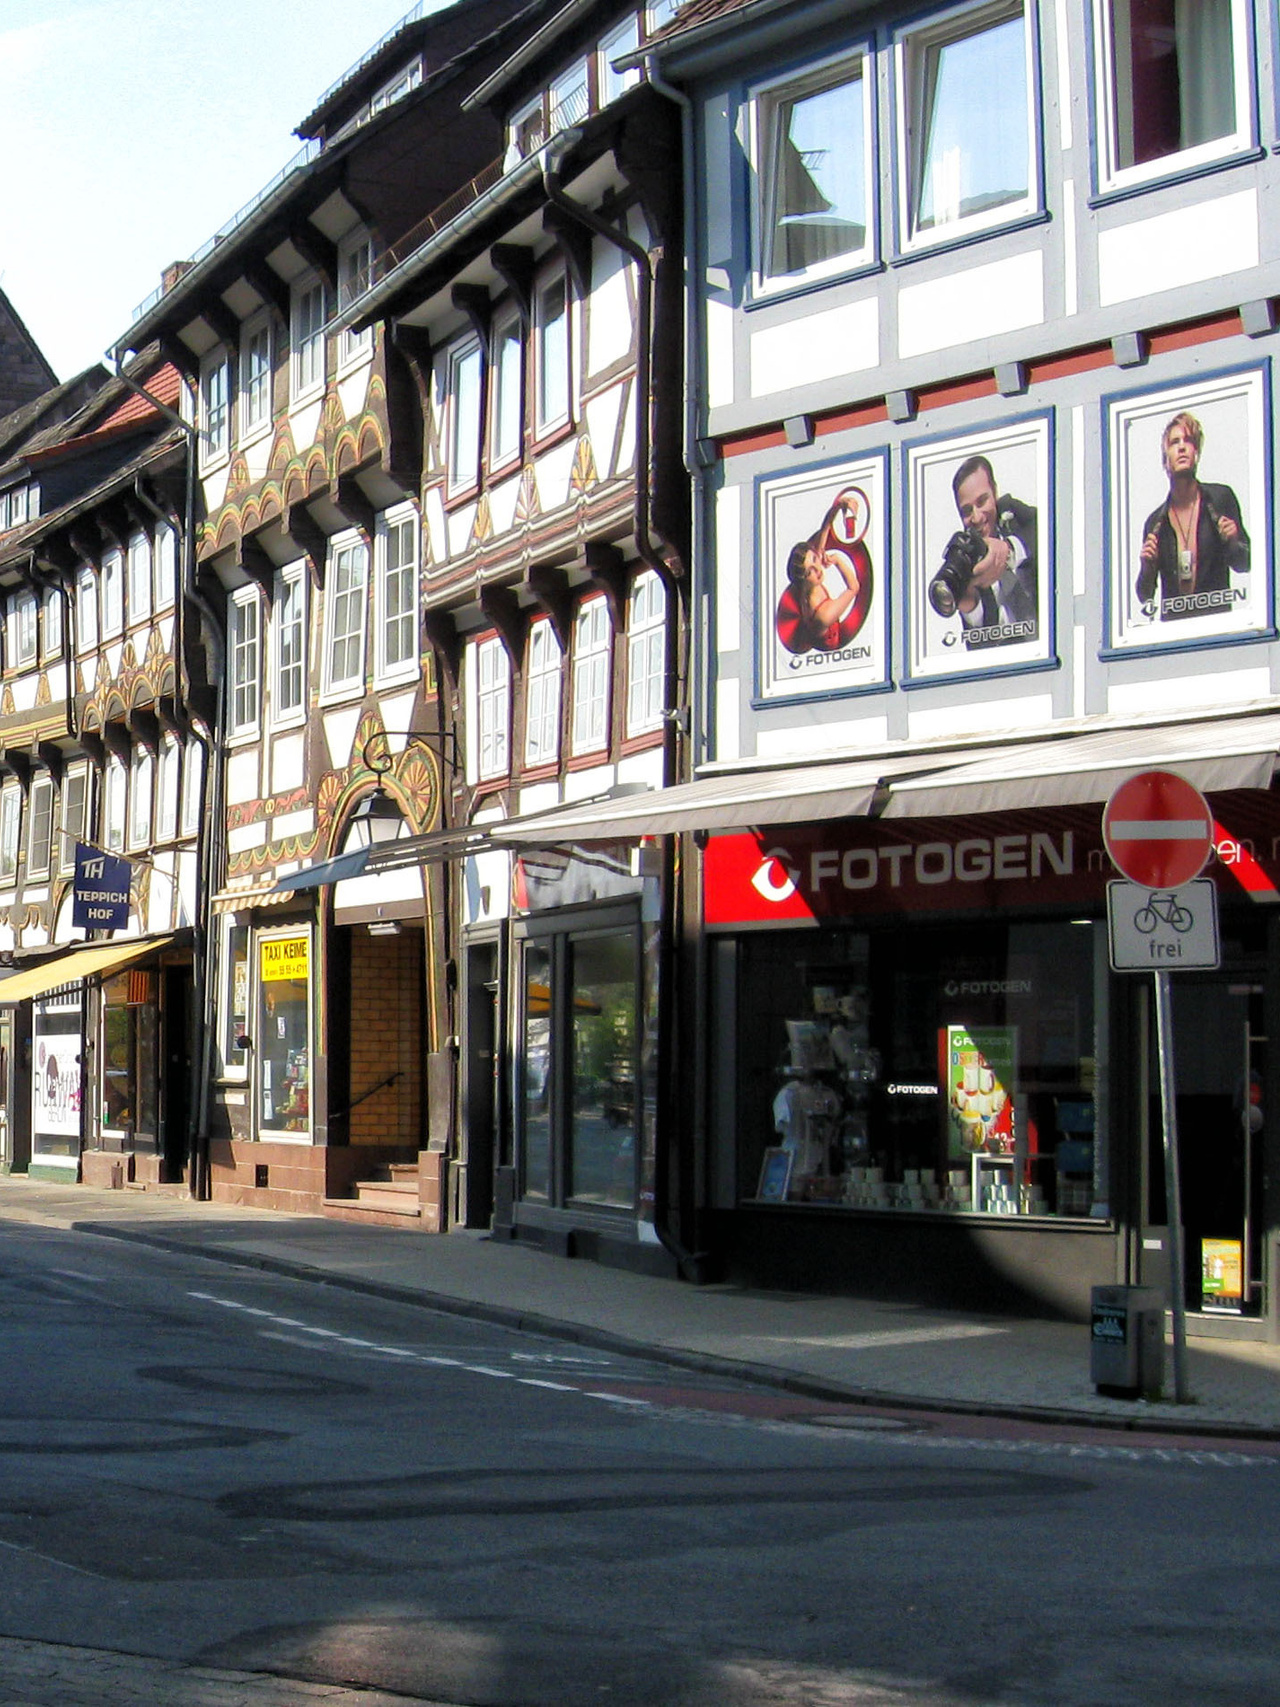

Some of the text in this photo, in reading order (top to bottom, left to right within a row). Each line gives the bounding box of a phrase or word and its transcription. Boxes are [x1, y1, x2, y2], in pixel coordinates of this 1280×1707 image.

[1162, 587, 1247, 615] FOTOGEN
[961, 620, 1035, 644] FOTOGEN
[806, 645, 871, 666] FOTOGEN
[810, 831, 1074, 892] FOTOGEN
[76, 890, 127, 903] TEPPICH
[88, 908, 114, 919] HOF
[264, 945, 281, 961] TAXI
[1150, 939, 1182, 958] frei
[961, 980, 1032, 993] FOTOGEN
[897, 1084, 938, 1095] FOTOGEN
